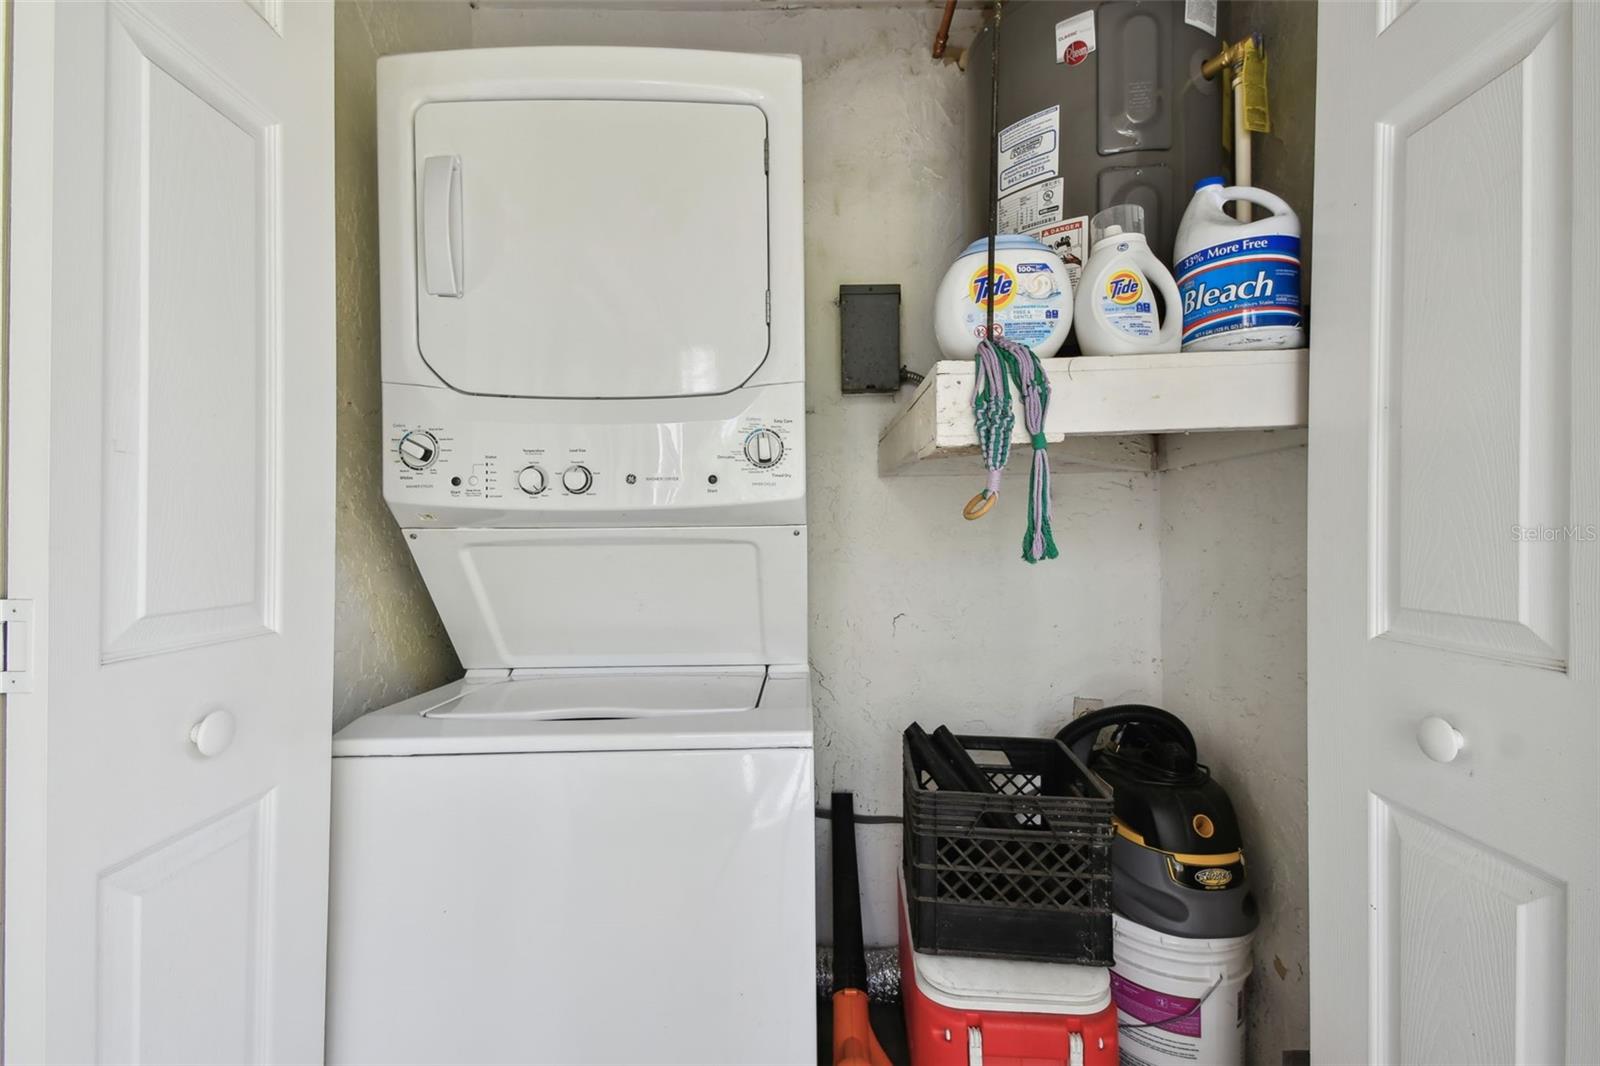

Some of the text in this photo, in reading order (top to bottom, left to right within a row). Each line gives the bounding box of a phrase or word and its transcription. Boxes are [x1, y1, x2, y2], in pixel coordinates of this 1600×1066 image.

[1050, 221, 1081, 235] DANGER
[1184, 239, 1269, 269] 33% More Free
[1110, 278, 1139, 299] Tide
[1183, 270, 1274, 316] Bleach
